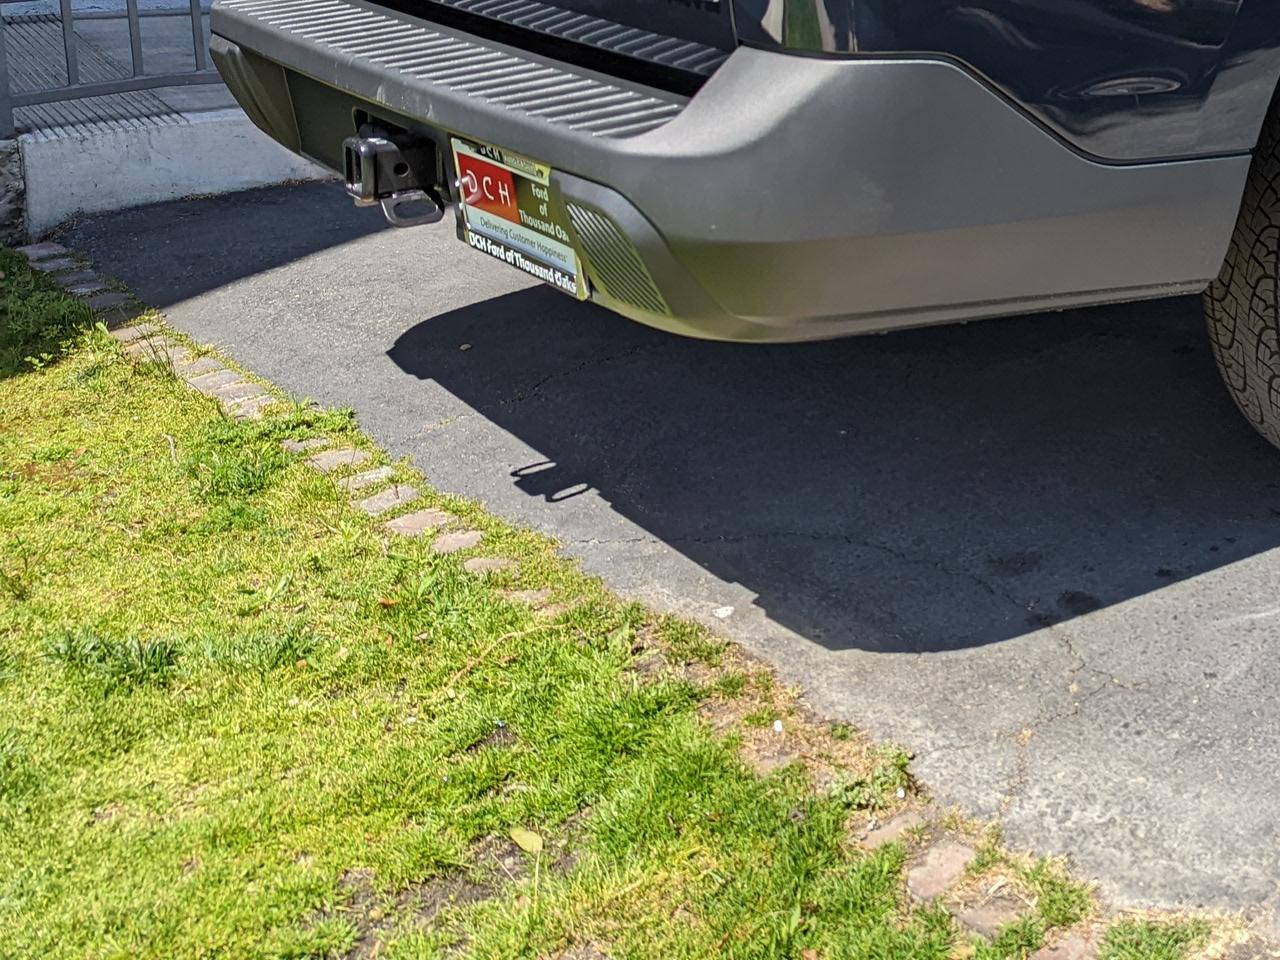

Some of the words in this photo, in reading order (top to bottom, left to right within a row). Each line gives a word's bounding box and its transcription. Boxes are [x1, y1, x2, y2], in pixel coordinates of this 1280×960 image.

[465, 170, 511, 207] DCH
[531, 183, 549, 202] Ford
[518, 209, 555, 236] Thousand
[539, 203, 548, 218] of
[480, 216, 509, 239] Delivering
[509, 227, 536, 248] Customer
[468, 231, 487, 252] DCH
[487, 238, 505, 260] Ford
[505, 249, 515, 264] of
[515, 253, 554, 283] Thousand
[554, 271, 577, 294] Oaks
